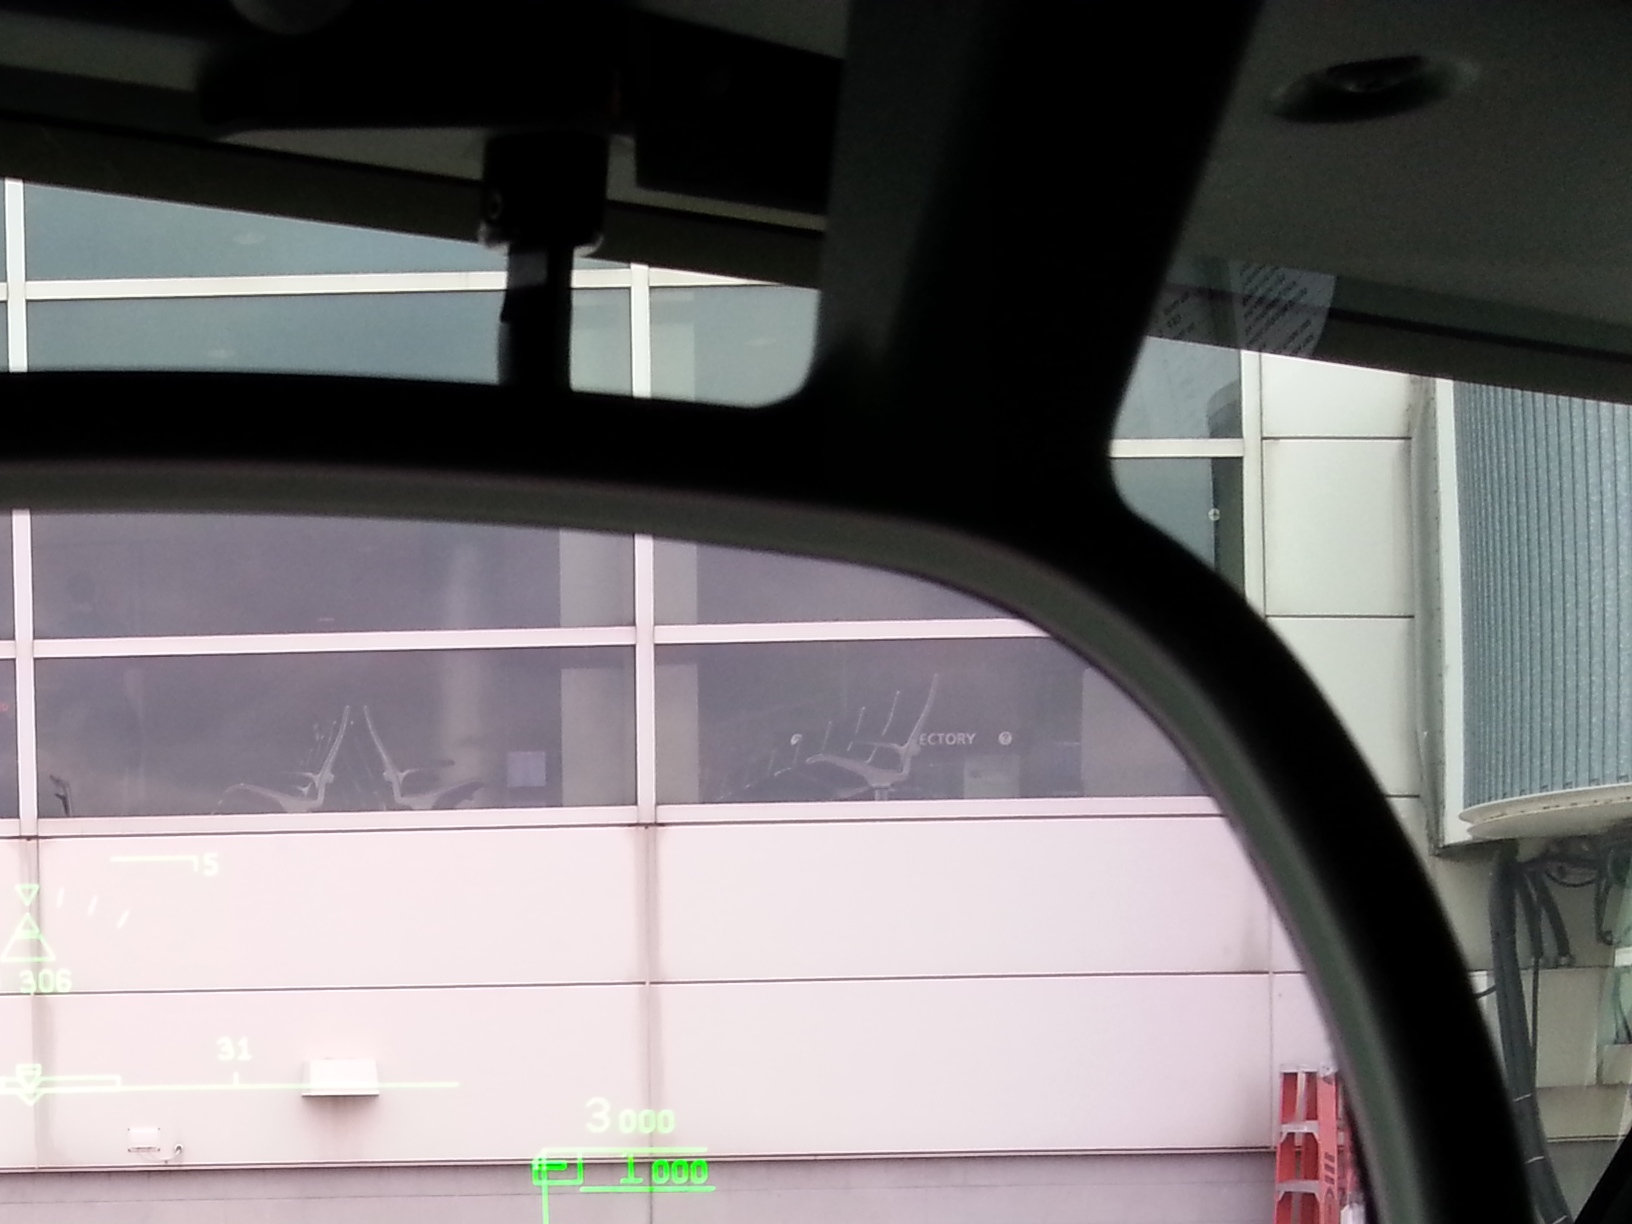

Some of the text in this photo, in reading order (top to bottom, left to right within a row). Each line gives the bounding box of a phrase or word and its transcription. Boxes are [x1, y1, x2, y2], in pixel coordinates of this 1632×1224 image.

[919, 732, 976, 746] ECTORY
[203, 852, 219, 877] 5
[19, 968, 72, 994] 306
[218, 1037, 252, 1062] 31
